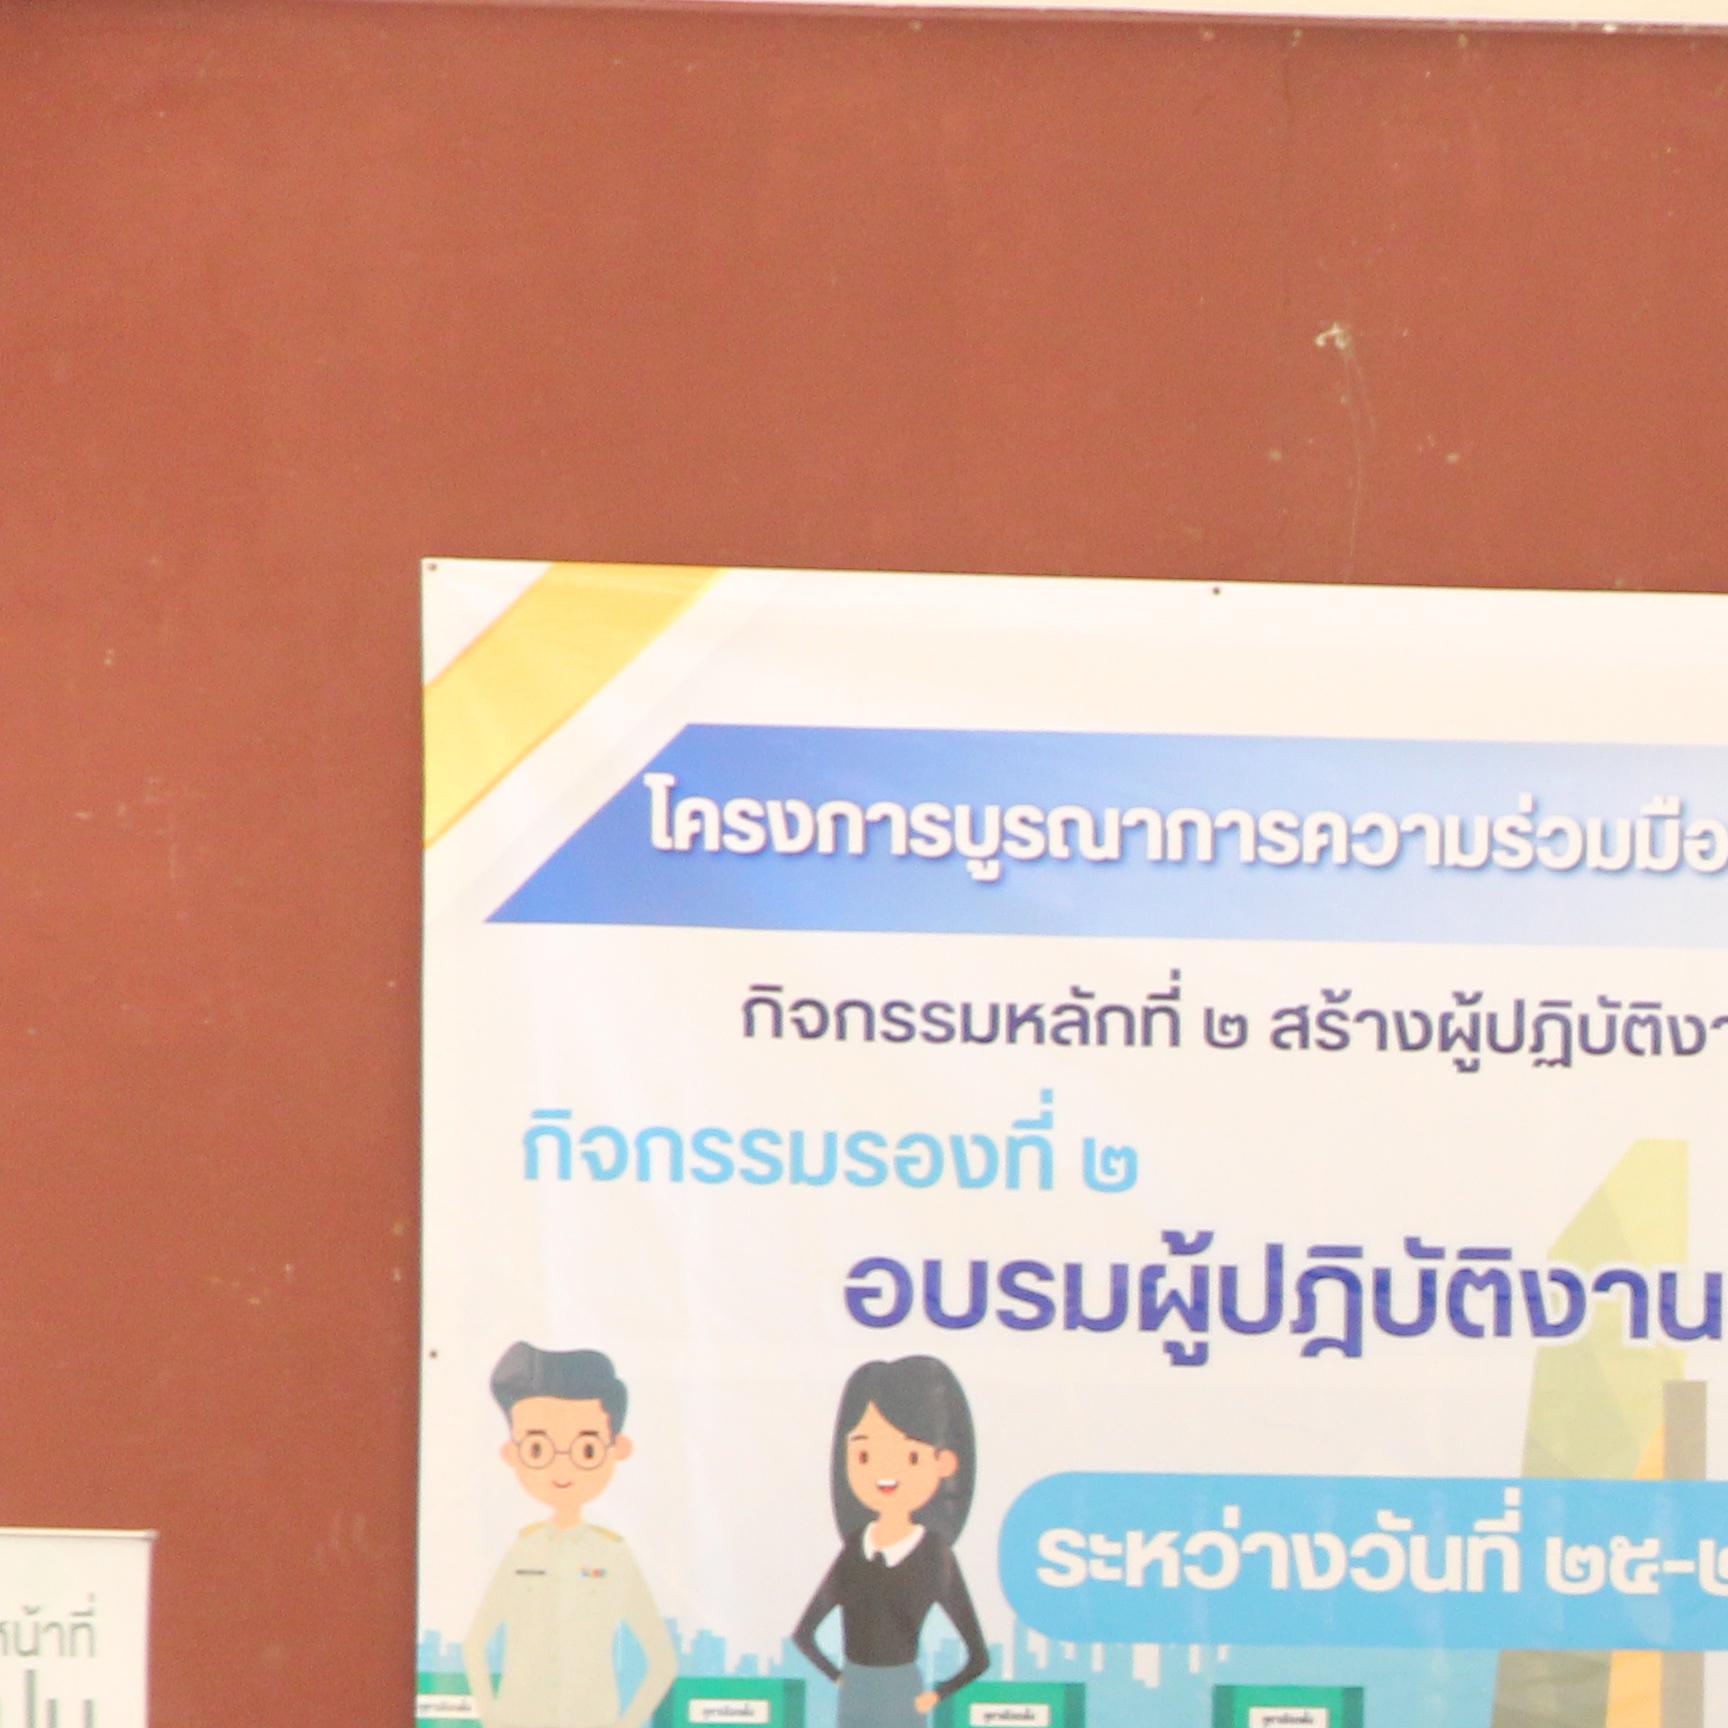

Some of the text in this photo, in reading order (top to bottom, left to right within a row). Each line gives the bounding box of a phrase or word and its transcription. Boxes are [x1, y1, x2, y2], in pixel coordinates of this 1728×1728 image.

[743, 969, 1181, 1048] กิจกรรมหลักที่
[1204, 1009, 1248, 1050] ๒
[523, 1089, 1139, 1193] กิจกรรมรองที่ ๒
[1037, 1490, 1520, 1593] ระหว่างวันที่
